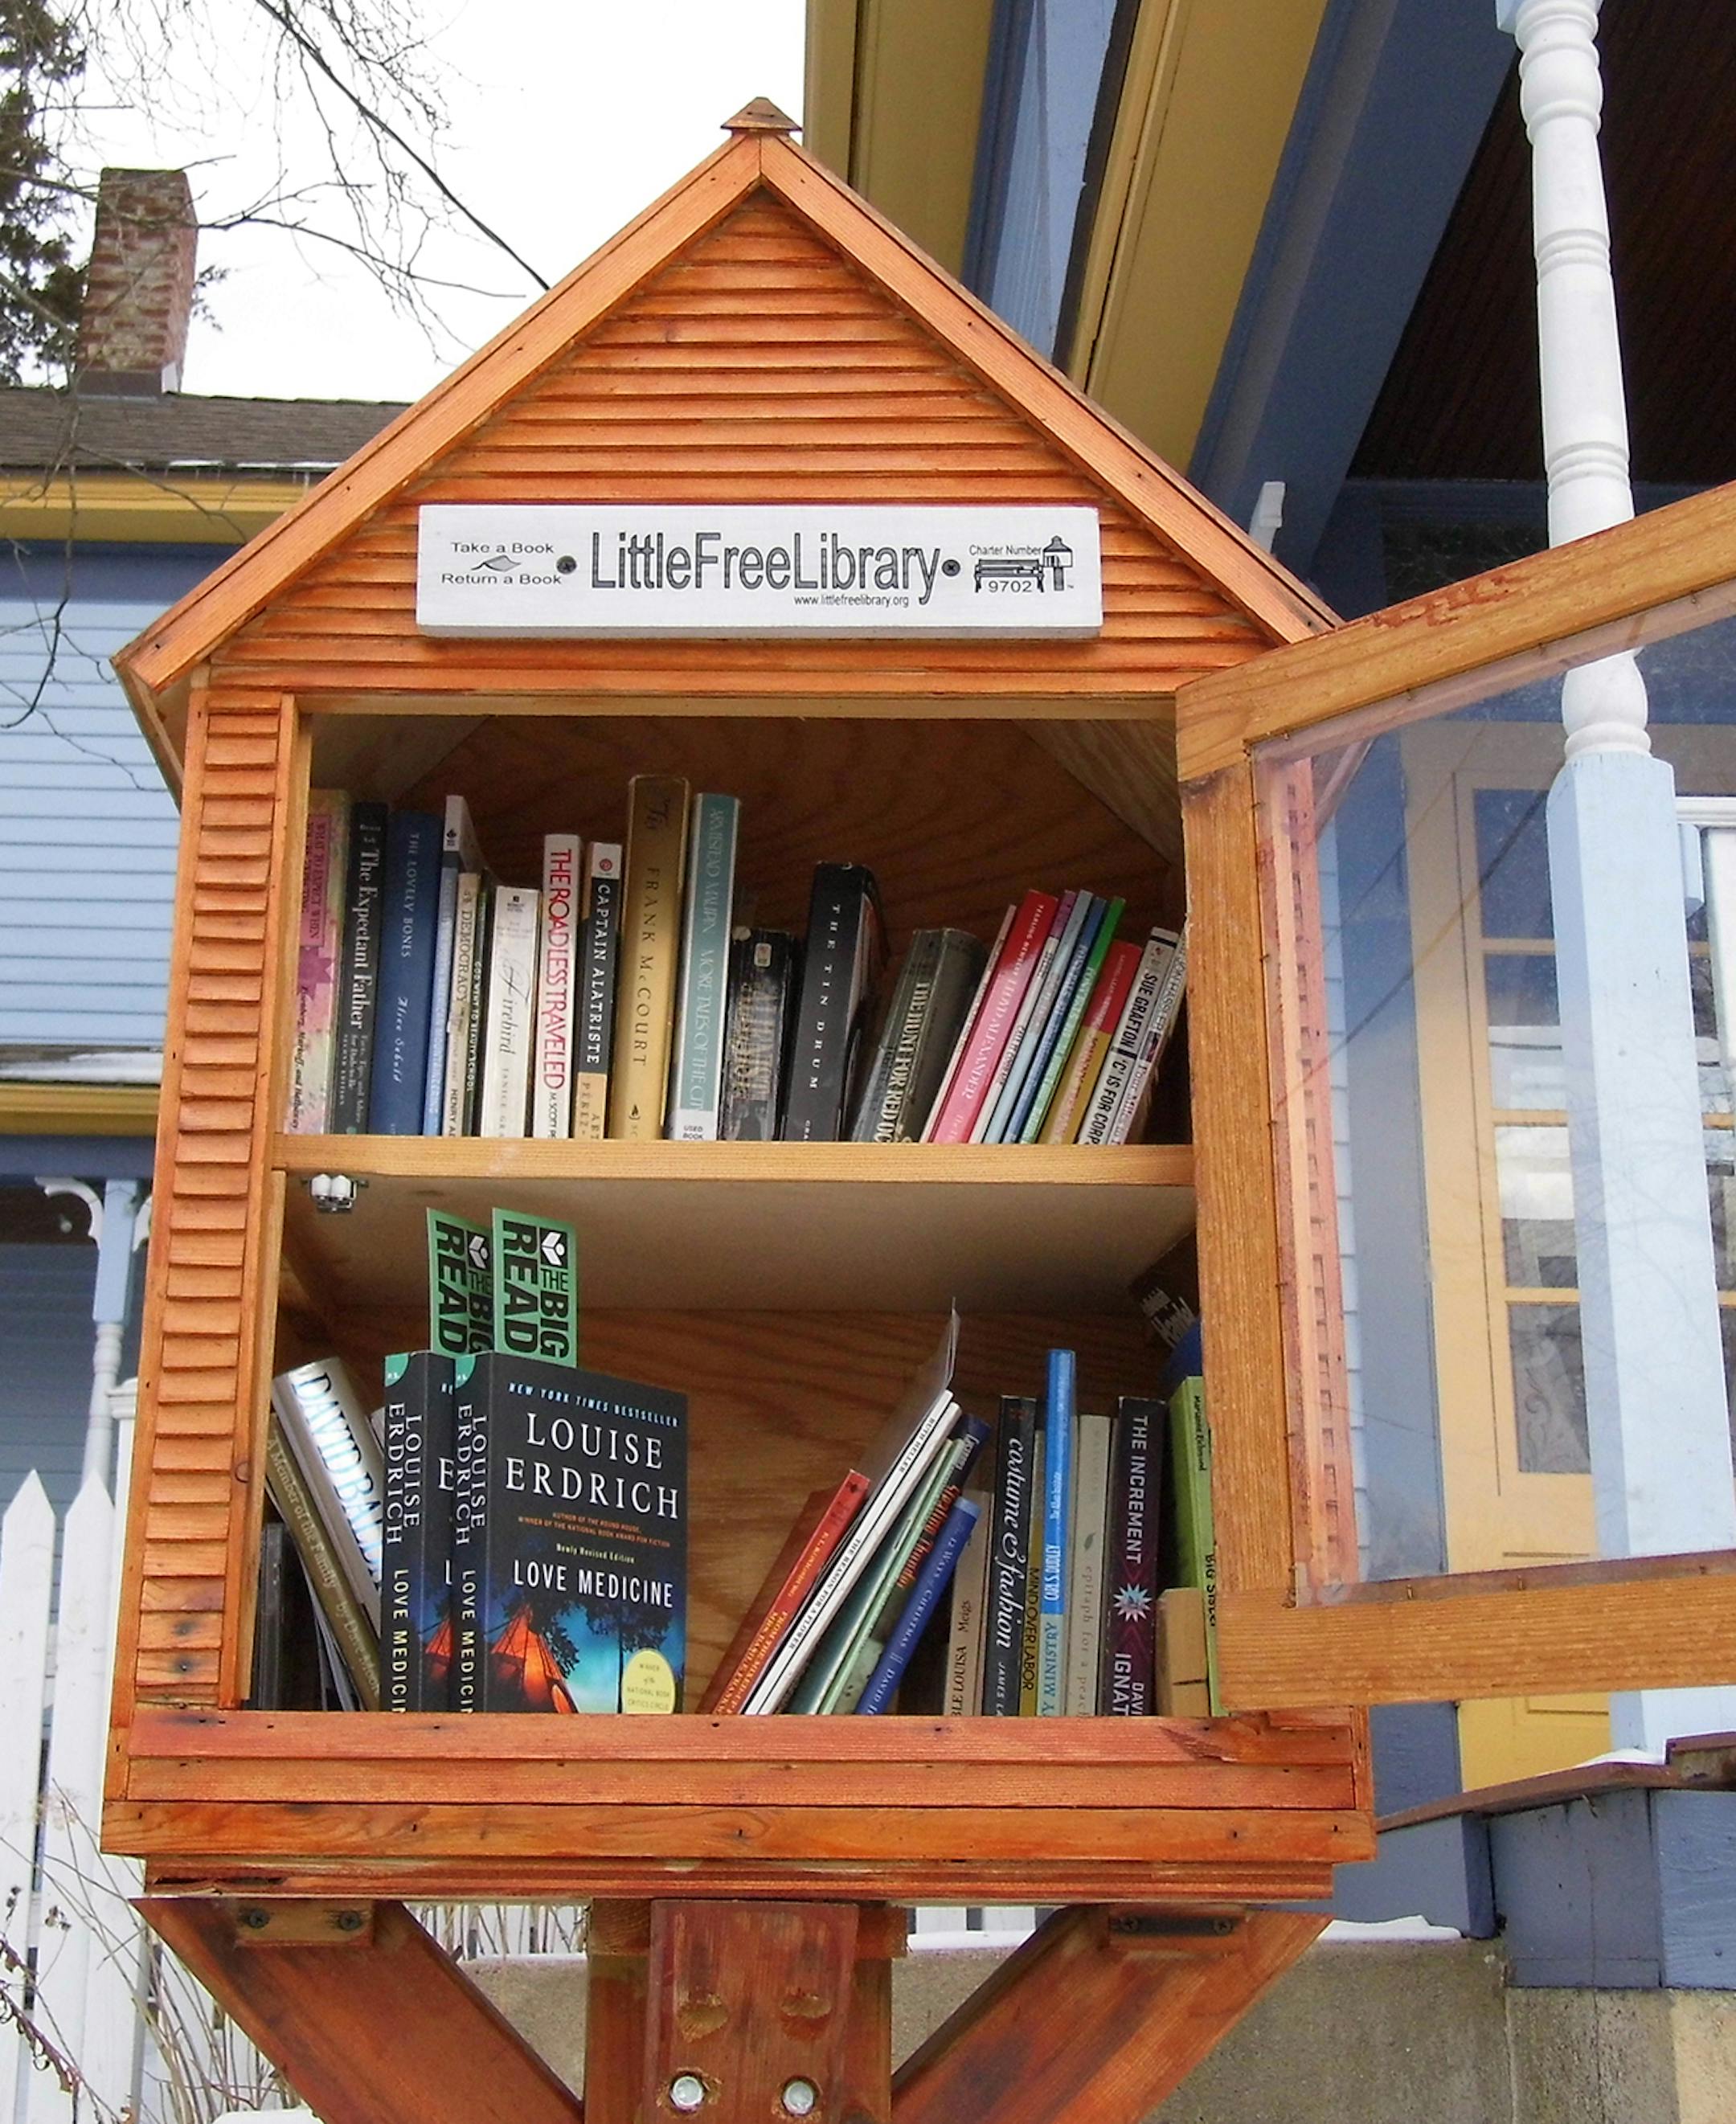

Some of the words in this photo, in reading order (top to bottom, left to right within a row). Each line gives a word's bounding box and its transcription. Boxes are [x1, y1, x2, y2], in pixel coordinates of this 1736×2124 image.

[451, 542, 490, 553] Take
[512, 542, 554, 553] Book
[968, 544, 1004, 556] Charter
[1005, 544, 1042, 556] Number
[442, 574, 497, 584] Return
[503, 576, 513, 584] a
[519, 574, 562, 584] Book
[591, 532, 940, 605] LittleFreeLibrary
[988, 580, 1033, 592] 9702
[793, 595, 909, 608] www.littlefreelibrary.org
[407, 832, 420, 854] THE
[706, 808, 723, 878] ARMISTEAD
[358, 849, 380, 882] The
[550, 849, 572, 886] THE
[403, 861, 418, 912] LOVELY
[641, 867, 661, 942] FRANK
[547, 887, 571, 947] ROAD
[592, 884, 611, 960] CAPTAIN
[702, 882, 719, 933] MAUPIN
[827, 903, 841, 949] THE
[352, 885, 379, 970] Expectant
[401, 916, 413, 958] BONES
[456, 910, 473, 1002] DEMOCRACY
[546, 948, 569, 986] LESS
[698, 949, 714, 990] MORE
[350, 974, 373, 1029] Father
[820, 964, 833, 1006] TIN
[908, 980, 931, 1013] THE
[1138, 972, 1158, 997] SUE
[396, 996, 409, 1031] Alice
[497, 953, 531, 1056] Firebird
[587, 967, 605, 1064] ALATRISTE
[633, 955, 654, 1067] McCOURT
[694, 997, 711, 1030] TALES
[1120, 997, 1149, 1050] GRAFTON
[541, 988, 567, 1090] TRAVELED
[693, 1033, 710, 1054] OF
[896, 1010, 925, 1055] HUNT
[392, 1037, 405, 1084] Sebold
[466, 1056, 477, 1092] SCHOOL
[690, 1058, 707, 1084] THE
[809, 1021, 825, 1090] DRUM
[887, 1054, 911, 1089] FOR
[962, 1017, 1001, 1099] ALEXANDER
[498, 1068, 510, 1107] JANICE
[1098, 1087, 1118, 1112] FOR
[1106, 1074, 1120, 1087] IS
[449, 1088, 459, 1123] HENRY
[548, 1102, 558, 1128] SCOTT
[878, 1087, 903, 1121] RED
[683, 1124, 704, 1132] USED
[435, 1220, 468, 1353] READ
[468, 1268, 492, 1297] THE
[502, 1219, 538, 1353] READ
[539, 1267, 569, 1292] THE
[469, 1291, 493, 1354] BIG
[540, 1291, 570, 1359] BIG
[509, 1381, 534, 1396] NEW
[540, 1388, 570, 1404] YORK
[575, 1395, 609, 1413] TIMES
[614, 1404, 678, 1428] BESTSELLER
[1194, 1395, 1204, 1431] Marianne
[526, 1412, 662, 1470] LOUISE
[917, 1416, 936, 1441] RUTH
[1131, 1414, 1148, 1450] THE
[386, 1402, 405, 1545] ERDRICH
[403, 1414, 423, 1529] LOUISE
[456, 1404, 473, 1545] ERDRICH
[470, 1415, 488, 1529] LOUISE
[897, 1440, 921, 1474] HELLER
[506, 1457, 679, 1520] ERDRICH
[1004, 1436, 1026, 1529] costume
[553, 1512, 576, 1522] AUTHOR
[578, 1515, 586, 1523] OF
[587, 1516, 600, 1525] THE
[1126, 1455, 1147, 1565] INCREMENT
[272, 1450, 298, 1504] Member
[293, 1501, 307, 1518] of
[300, 1514, 317, 1544] the
[310, 1539, 337, 1589] Family
[335, 1600, 350, 1619] by
[518, 1516, 542, 1527] WINNER
[544, 1519, 554, 1528] OF
[555, 1520, 566, 1530] THE
[567, 1523, 596, 1536] NATIONAL
[598, 1529, 615, 1538] BOOK
[616, 1531, 635, 1542] AWARD
[636, 1534, 648, 1544] FOR
[649, 1537, 670, 1548] FICTION
[847, 1537, 861, 1554] THE
[946, 1536, 957, 1548] 12
[1002, 1530, 1027, 1564] &
[555, 1542, 577, 1556] Newly
[579, 1546, 608, 1561] Revised
[609, 1550, 635, 1565] Edition
[826, 1554, 850, 1590] REASON
[392, 1569, 409, 1620] LOVE
[461, 1569, 477, 1621] LOVE
[513, 1559, 567, 1592] LOVE
[578, 1568, 674, 1608] MEDICINE
[814, 1589, 829, 1608] FOR
[993, 1554, 1026, 1648] fashion
[1026, 1568, 1040, 1603] MIND
[1079, 1566, 1093, 1623] epitaph
[768, 1610, 788, 1639] FROM
[788, 1614, 813, 1651] FLOWER
[898, 1587, 935, 1649] CHRISTMAS
[957, 1600, 972, 1633] Meigs
[1025, 1606, 1038, 1643] OVER
[757, 1639, 772, 1659] THE
[1043, 1622, 1058, 1698] MINISTRY
[1083, 1631, 1093, 1651] for
[954, 1646, 968, 1681] LOUISA
[997, 1661, 1006, 1699] JAMES
[1022, 1647, 1036, 1691] LABOR
[871, 1667, 896, 1703] DAVID
